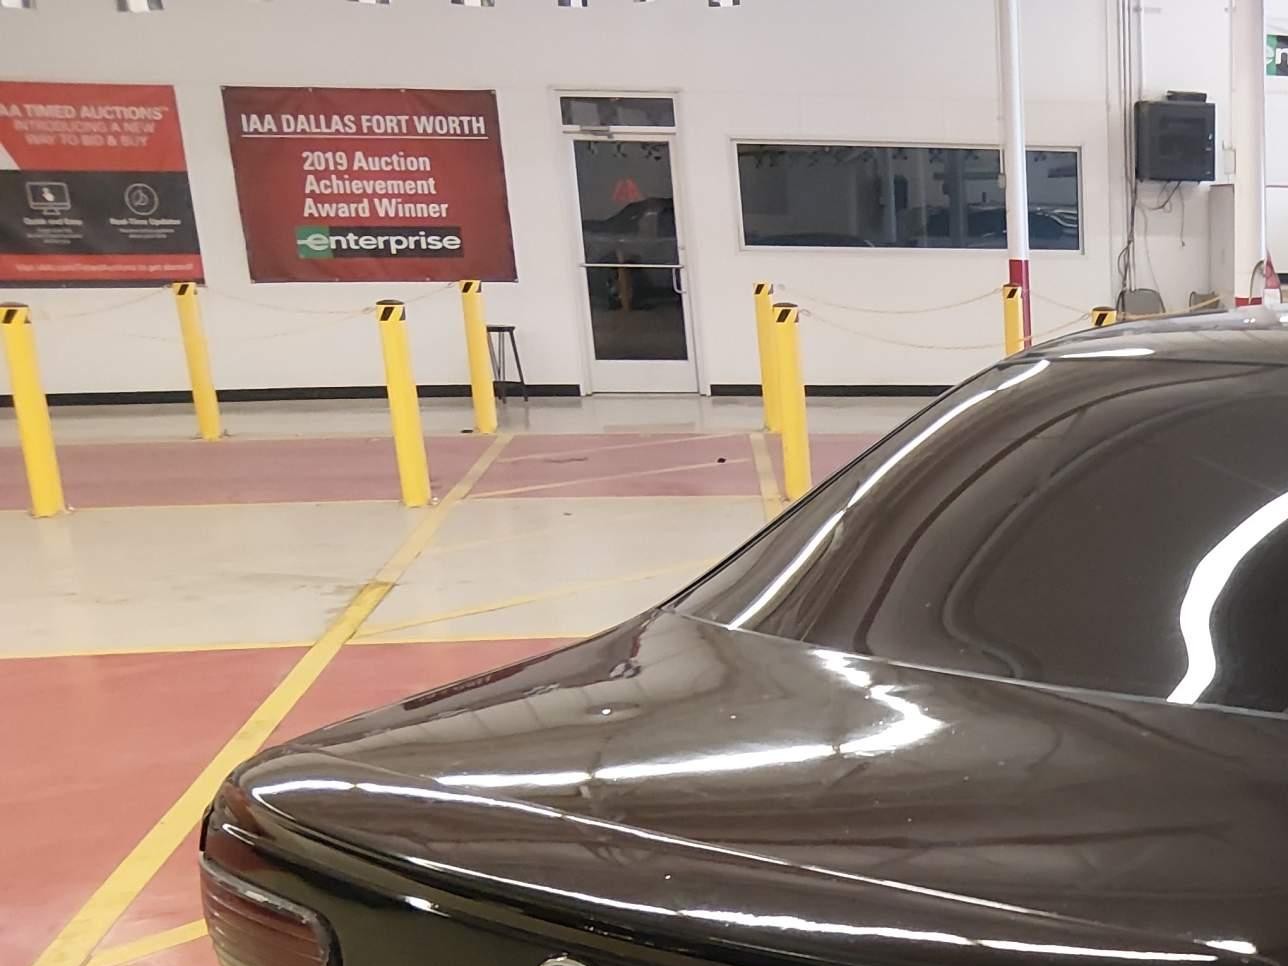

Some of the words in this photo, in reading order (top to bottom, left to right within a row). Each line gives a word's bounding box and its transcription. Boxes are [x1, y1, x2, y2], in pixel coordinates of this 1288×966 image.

[241, 113, 277, 132] IAA
[281, 114, 357, 133] DALLAS
[361, 115, 408, 134] FORT
[413, 116, 486, 135] WORTH
[302, 151, 348, 171] 2019
[353, 152, 431, 171] Auction
[305, 175, 436, 194] Achievement
[303, 198, 370, 217] Award
[373, 199, 448, 218] Winner
[297, 231, 461, 254] enterprise
